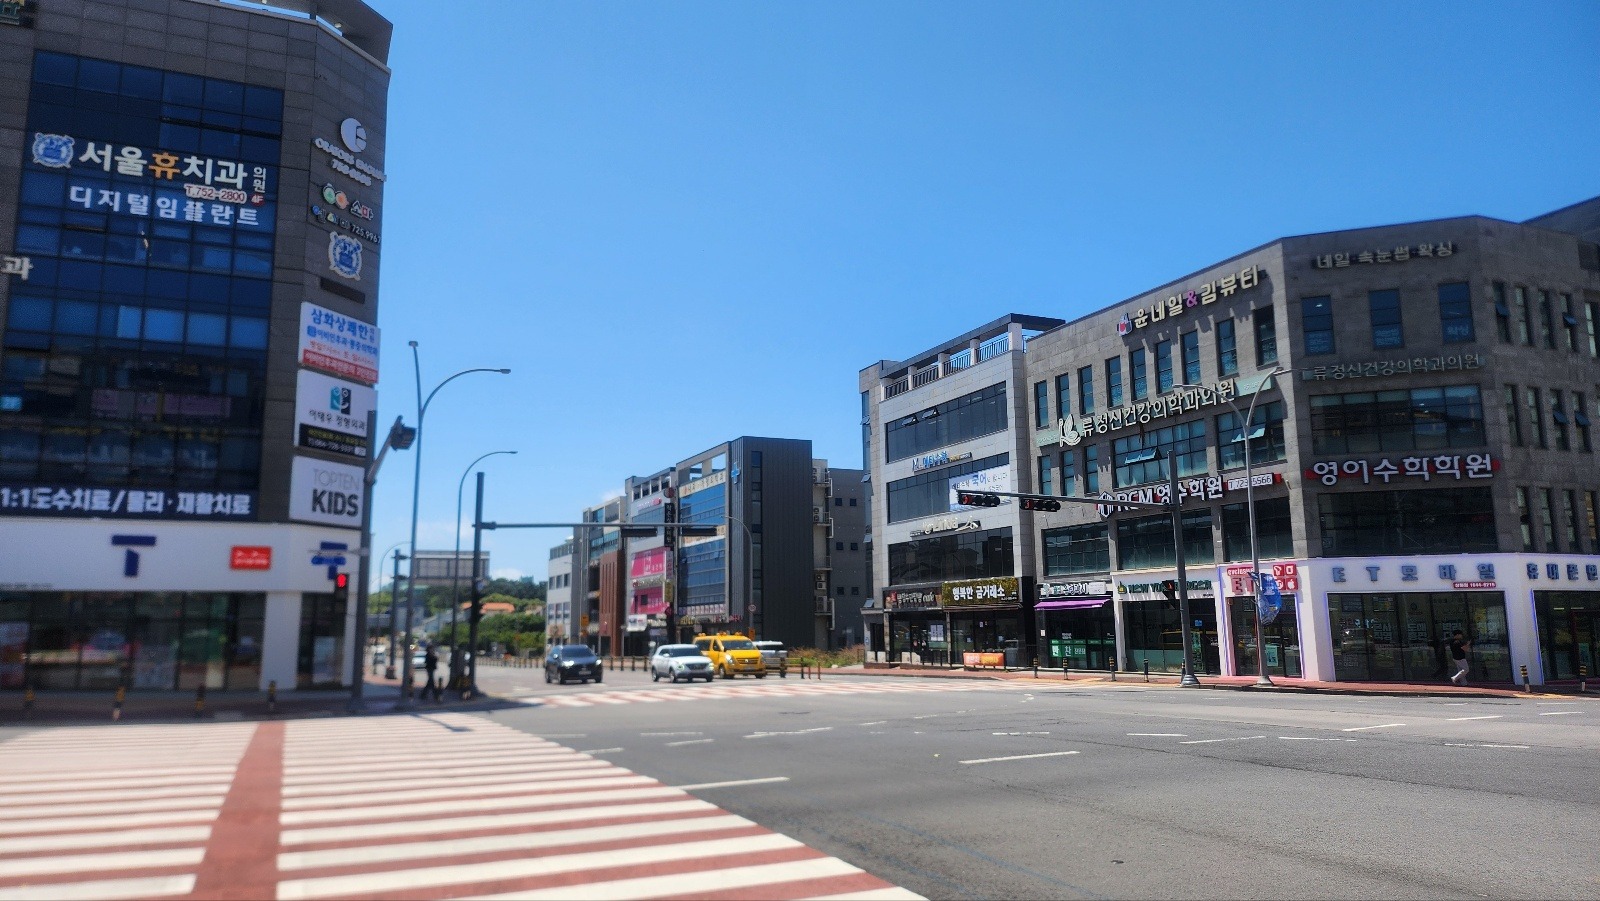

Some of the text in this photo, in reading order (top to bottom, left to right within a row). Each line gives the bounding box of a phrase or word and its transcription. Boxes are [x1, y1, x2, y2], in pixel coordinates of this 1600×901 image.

[79, 140, 247, 189] 서울휴치과
[253, 166, 266, 193] 의원
[185, 184, 247, 204] T.752-2800
[1418, 241, 1453, 258] 왁싱
[1313, 353, 1480, 381] 류정신건강의학과의원
[1079, 378, 1236, 438] 류정신건강의학과의원
[312, 467, 360, 492] TOPTEN
[1313, 454, 1494, 486] 영이수학학원
[312, 488, 359, 518] KIDS
[952, 586, 974, 601] 행복한
[975, 584, 1006, 600] 금거래소
[1127, 583, 1150, 594] NEW
